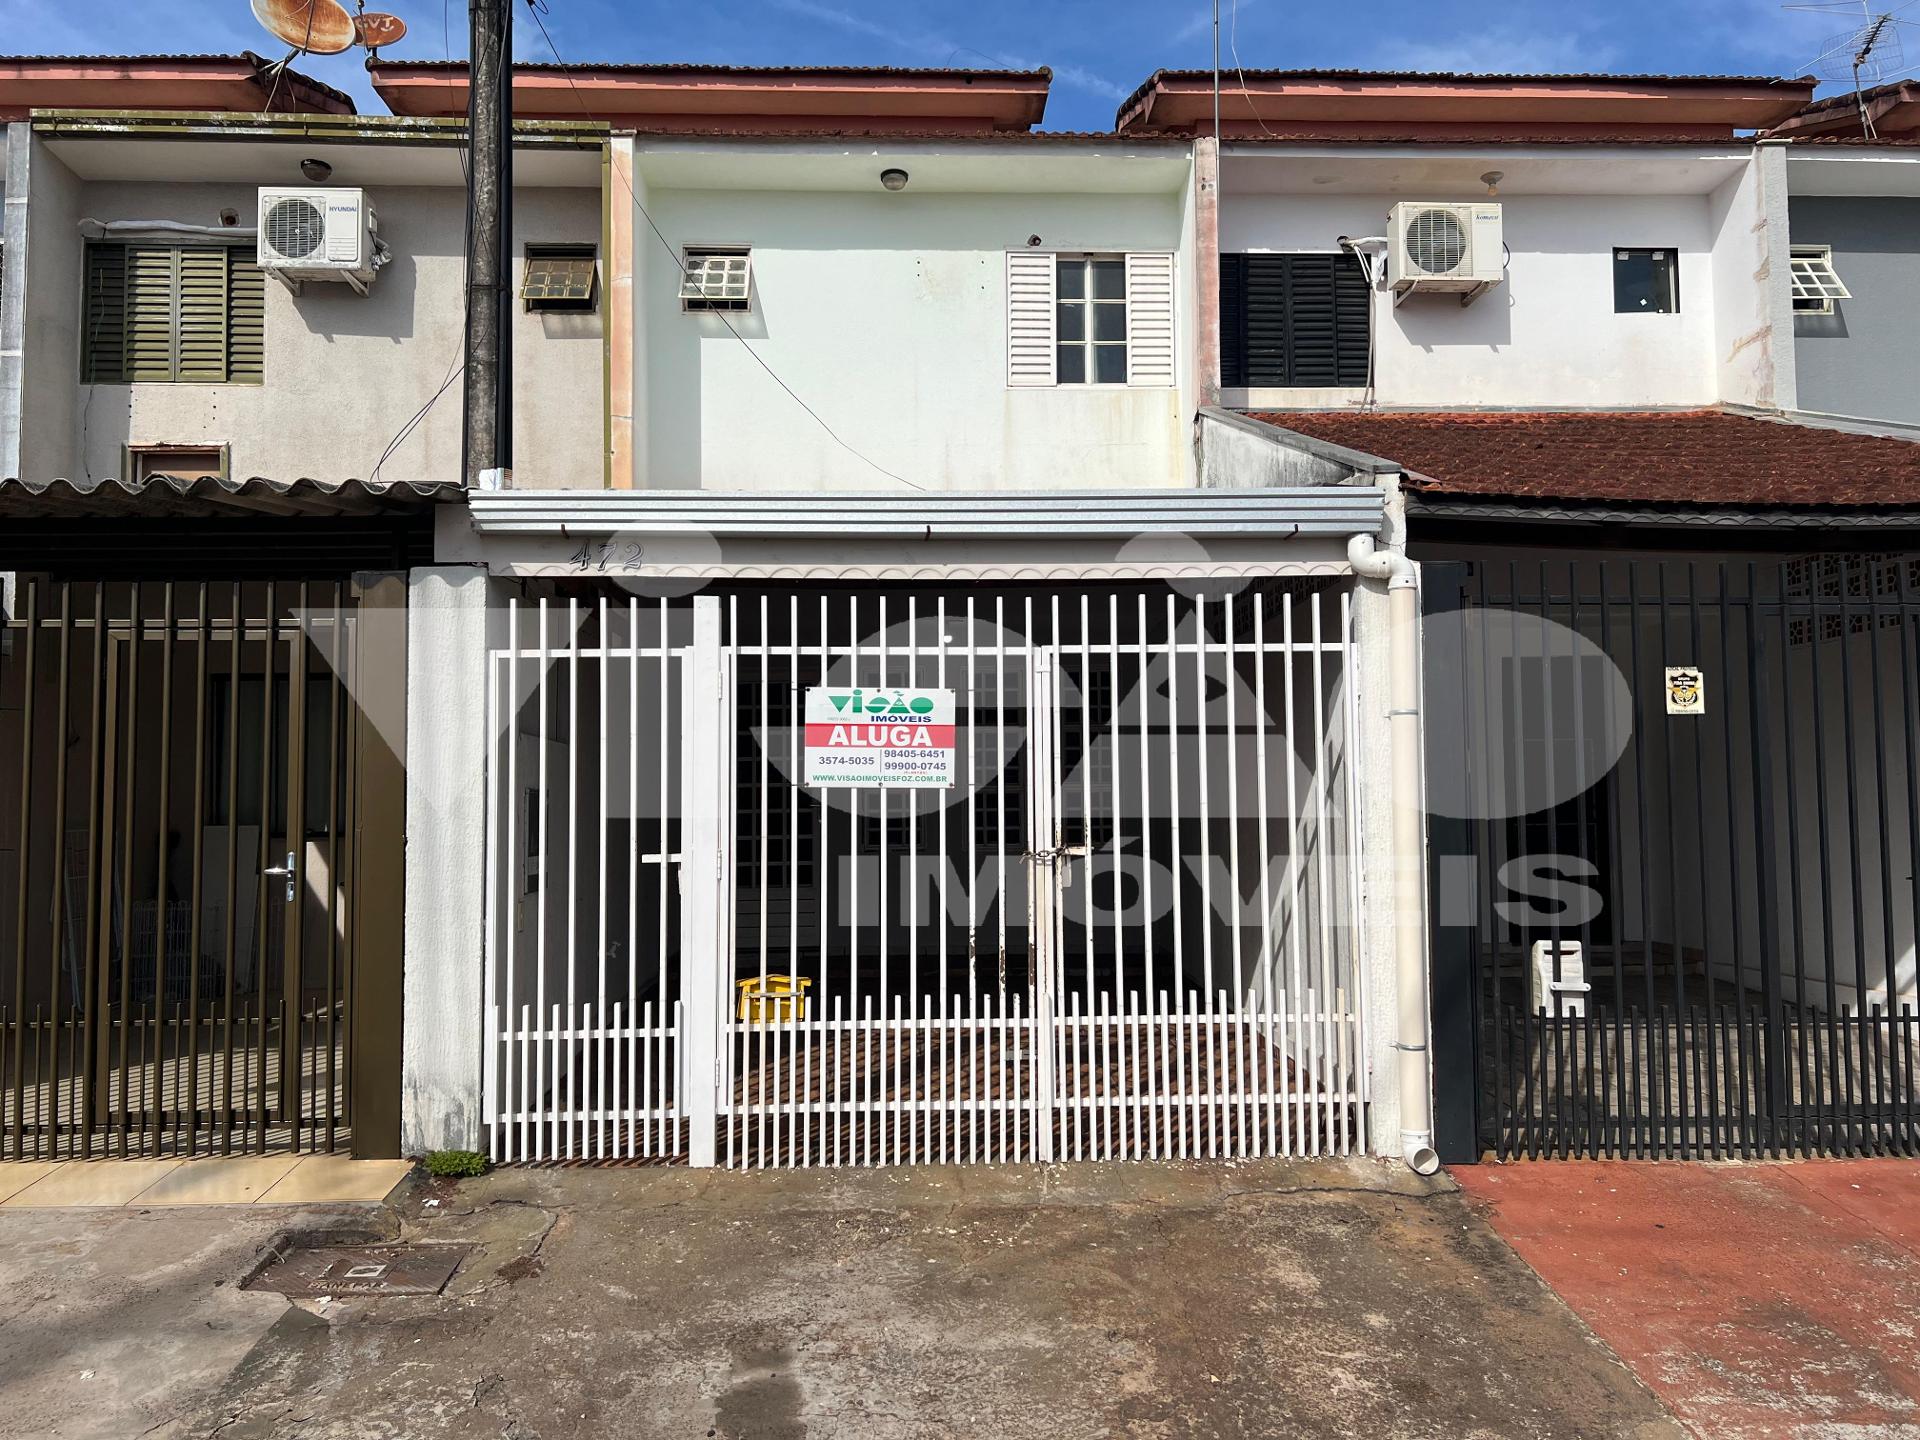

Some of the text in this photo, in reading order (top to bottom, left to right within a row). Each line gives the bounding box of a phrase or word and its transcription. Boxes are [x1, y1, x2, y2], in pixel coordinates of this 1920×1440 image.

[569, 539, 644, 572] 472
[870, 714, 932, 723] IMÓVEIS
[828, 725, 933, 747] ALUGA
[884, 749, 945, 758] 98405-6451
[818, 756, 875, 765] 3574-5035
[884, 762, 946, 770] 99900-0745
[812, 774, 948, 783] WWW.VISAOIMOVEISFOZ.COM.BR
